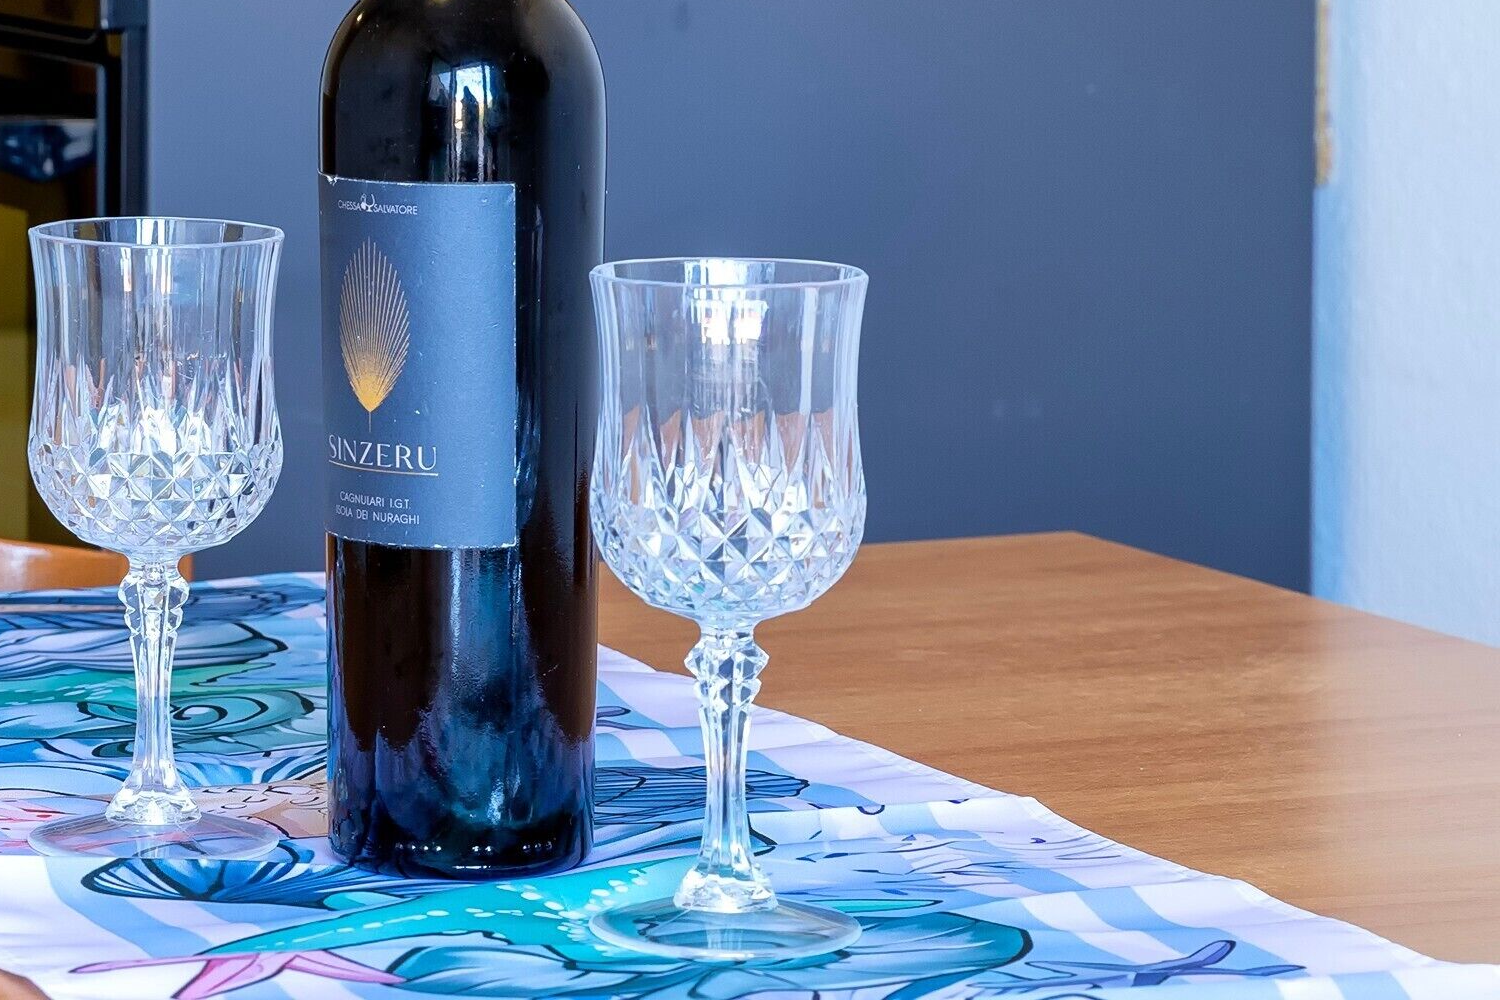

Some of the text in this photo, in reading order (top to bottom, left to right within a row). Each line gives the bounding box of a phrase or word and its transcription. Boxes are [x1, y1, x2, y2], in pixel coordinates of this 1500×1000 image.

[338, 199, 418, 215] CHESSA SALVATORE
[328, 434, 437, 470] SINZERU
[339, 491, 411, 510] CAGNULARI I.G.T.
[335, 505, 420, 525] ISOLA DEI NURAGHI
